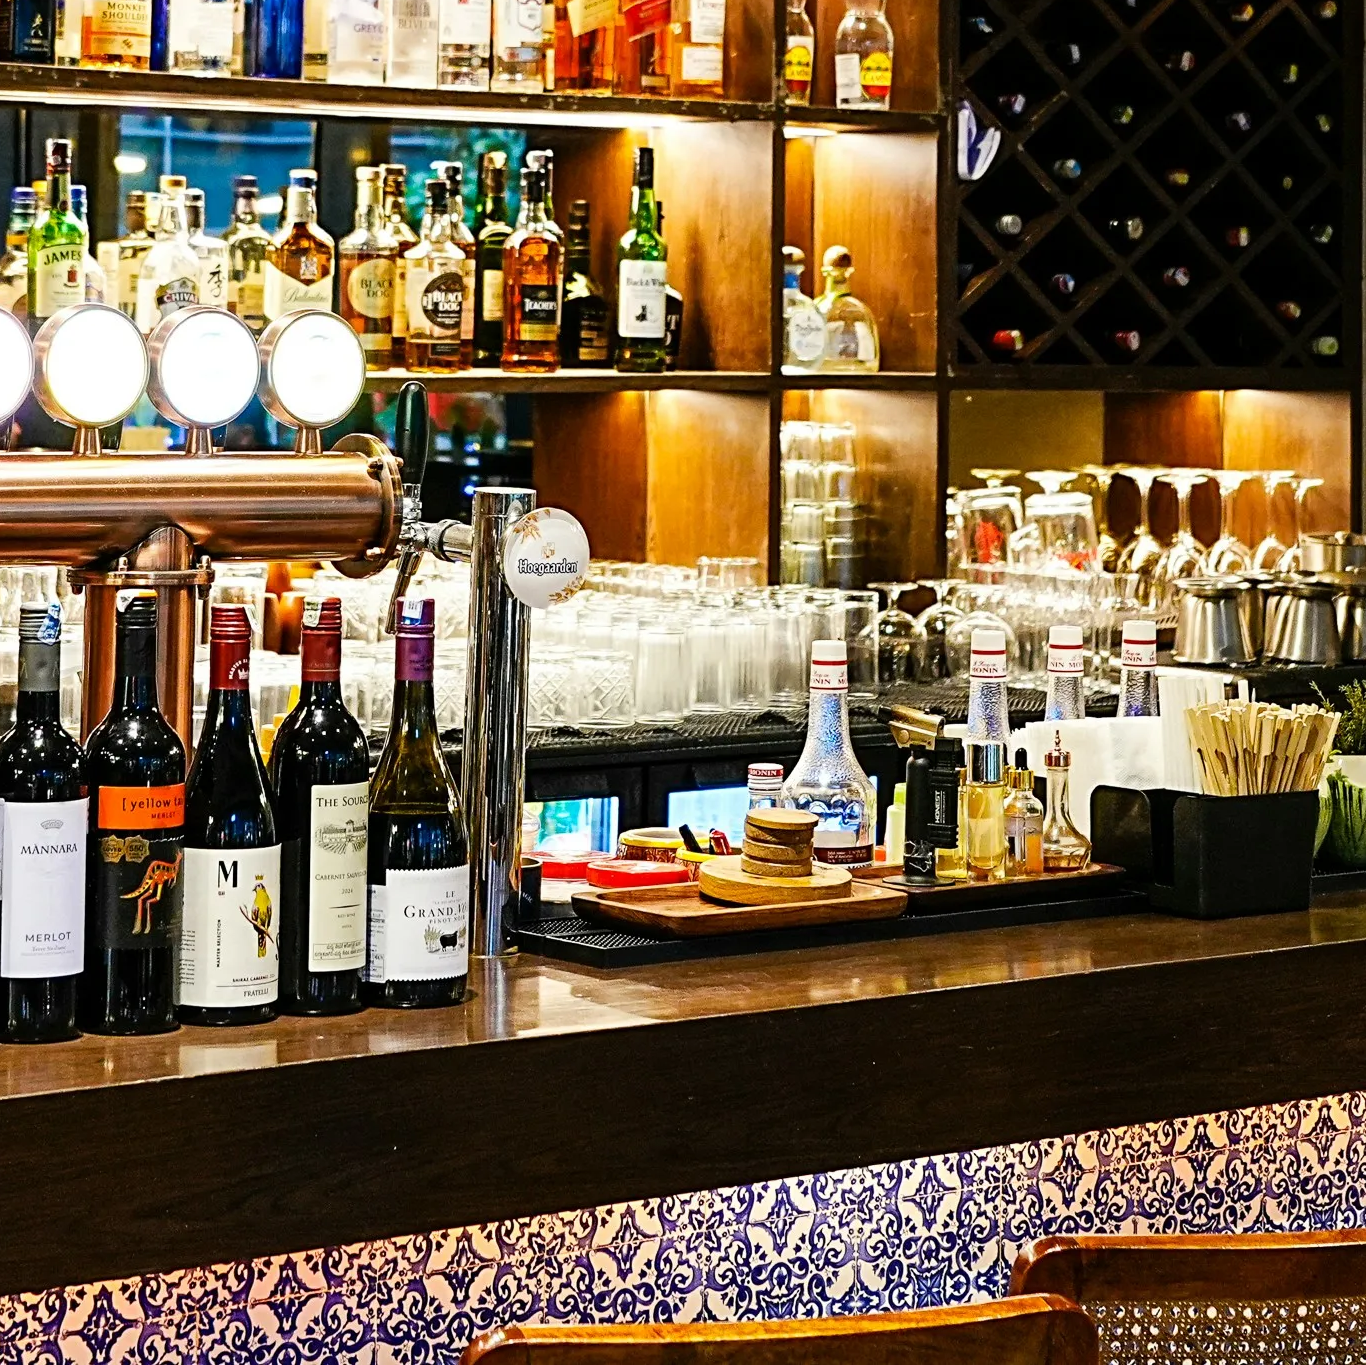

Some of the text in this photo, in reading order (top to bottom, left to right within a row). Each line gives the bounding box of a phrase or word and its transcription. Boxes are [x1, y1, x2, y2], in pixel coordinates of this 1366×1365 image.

[353, 23, 379, 34] GREY
[438, 302, 460, 312] DOG
[518, 558, 578, 576] Hoegaarden
[130, 798, 171, 812] yellow
[316, 797, 338, 808] THE
[218, 860, 238, 888] M
[315, 873, 345, 882] CABERNET
[25, 931, 71, 943] MERLOT
[243, 988, 269, 997] FRATELLI
